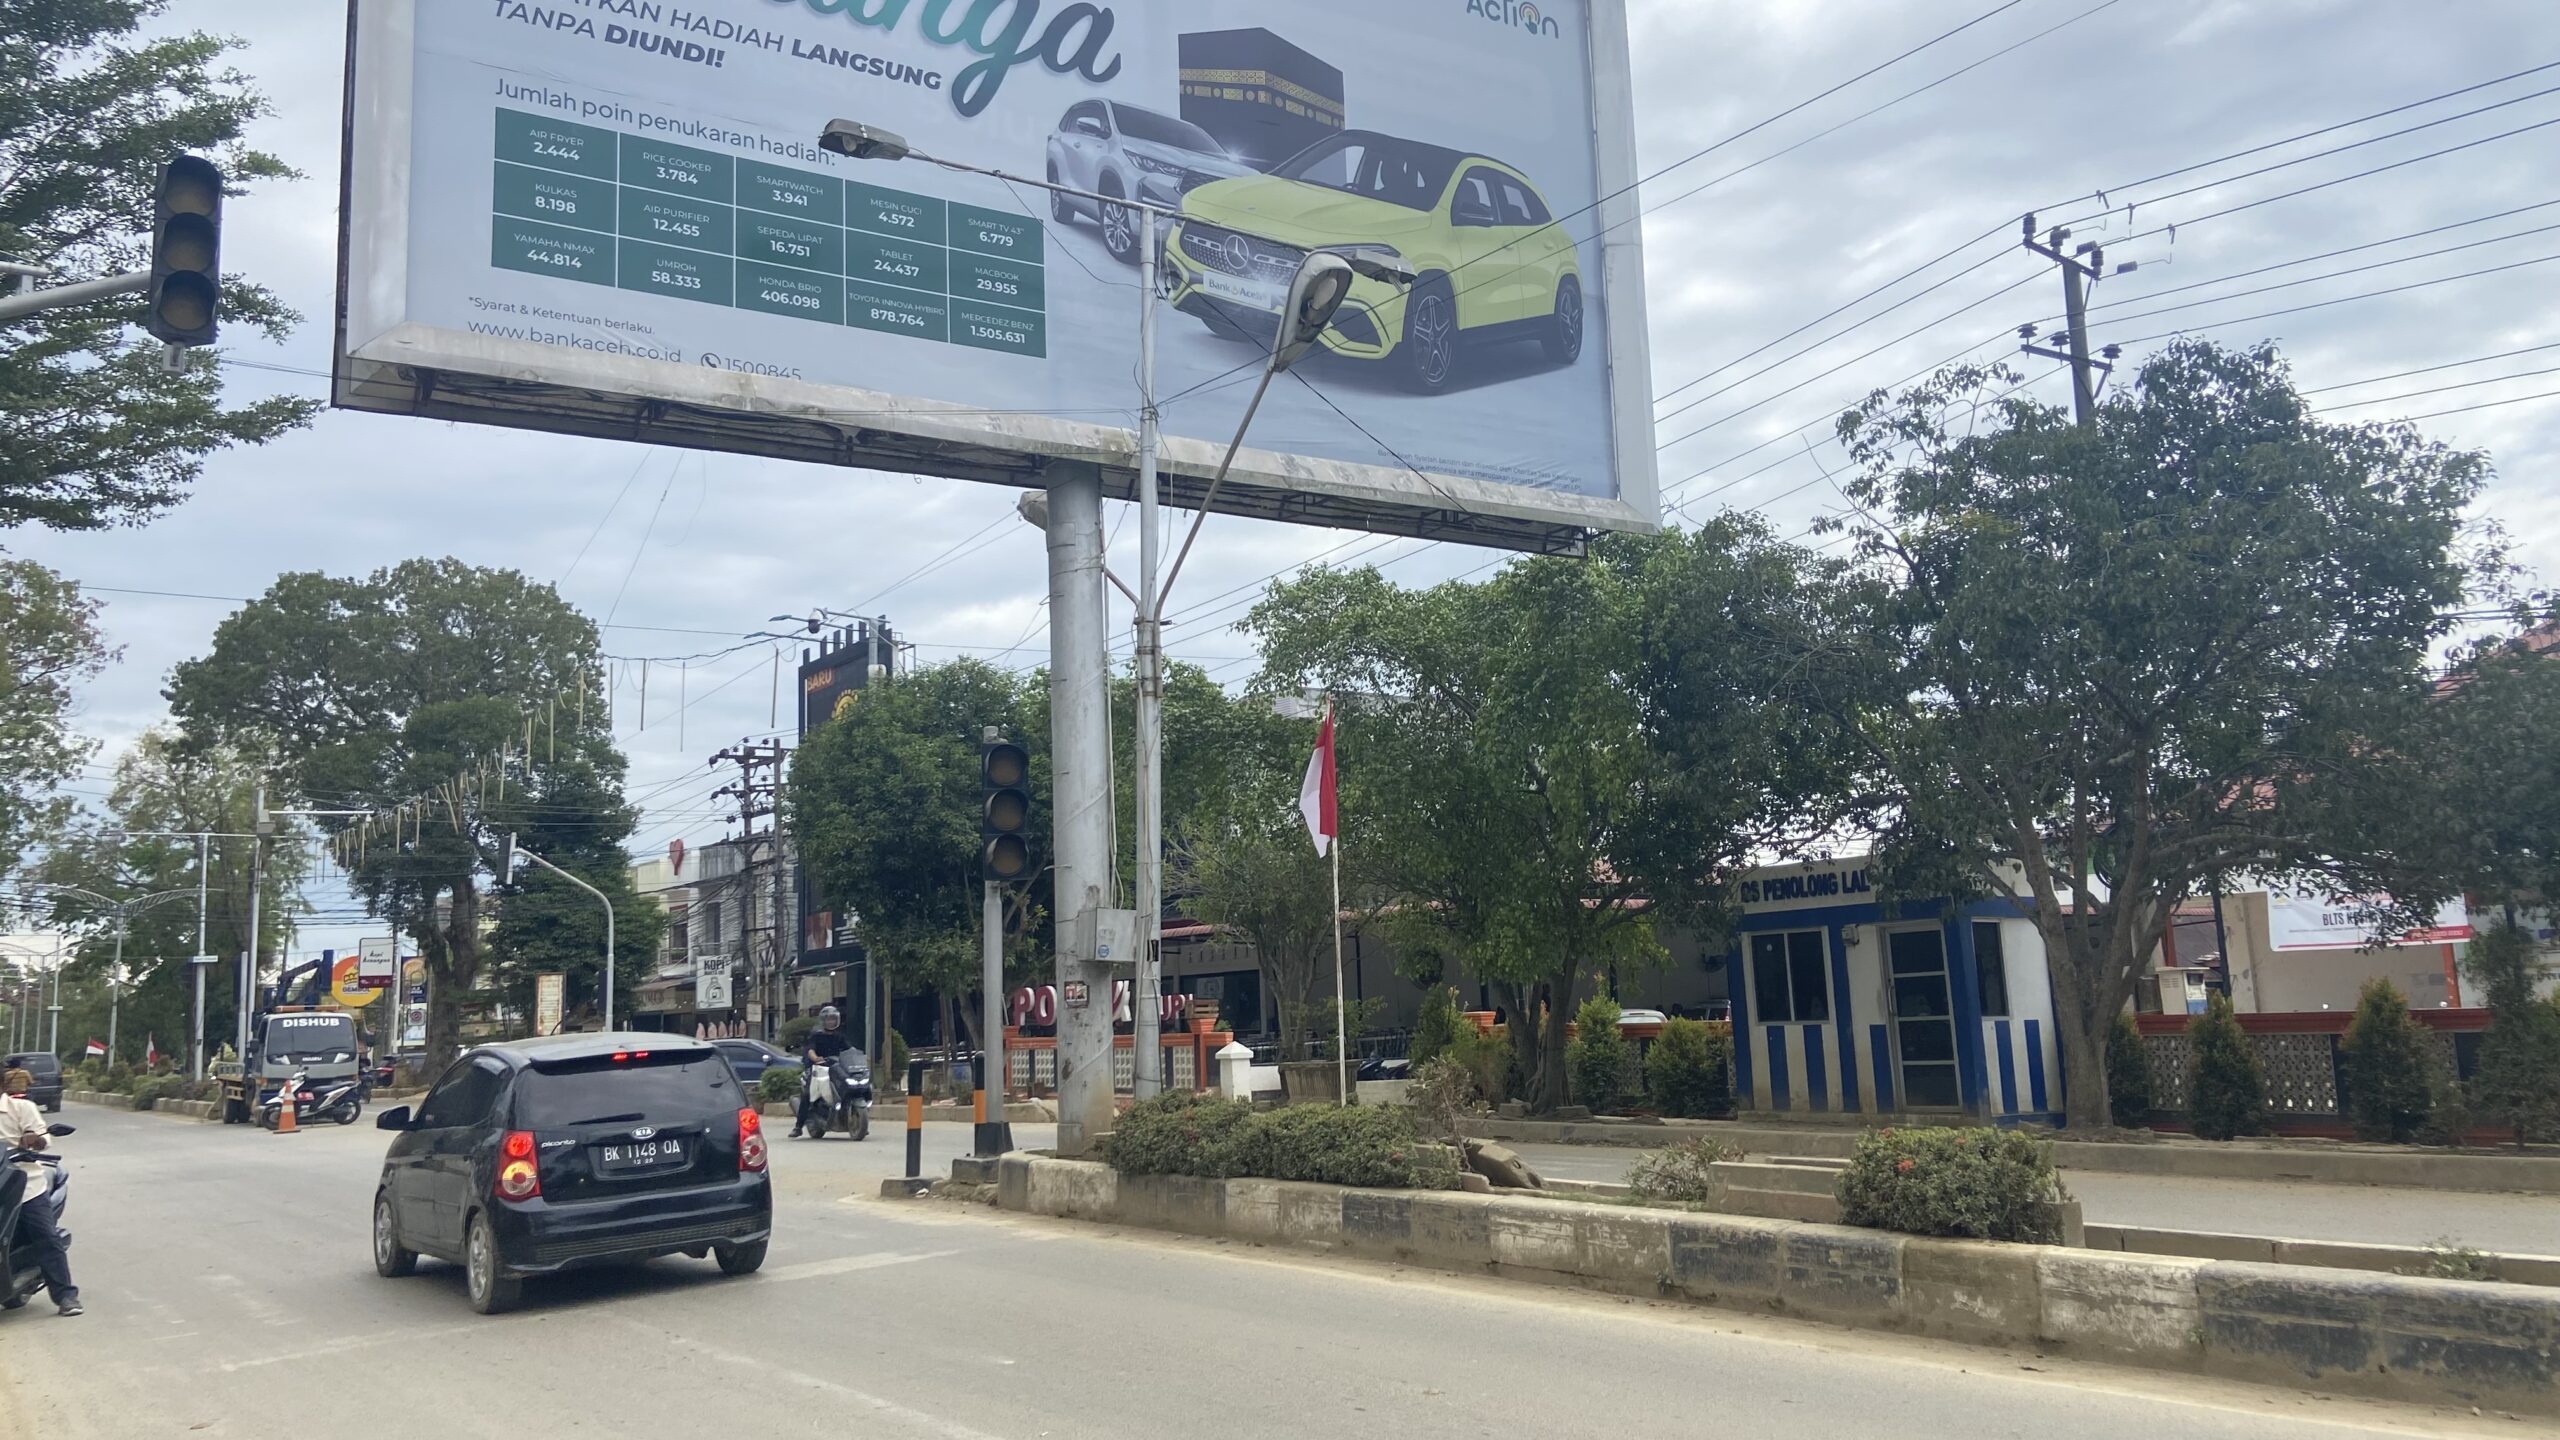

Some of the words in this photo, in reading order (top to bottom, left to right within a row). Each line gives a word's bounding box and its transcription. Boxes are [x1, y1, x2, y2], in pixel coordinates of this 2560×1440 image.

[496, 0, 596, 39] TANPA
[604, 23, 726, 69] DIUNDI!
[670, 9, 785, 52] HADIAH
[791, 38, 943, 91] LANGSUNG
[495, 78, 577, 112] Jumlah
[582, 98, 633, 124] poin
[638, 109, 754, 149] penukaran
[760, 133, 836, 167] hadiah:
[529, 129, 547, 139] AIR
[550, 133, 584, 146] FRYER
[533, 141, 580, 161] 2.444
[643, 152, 666, 164] RICE
[669, 157, 712, 173] COOKER
[656, 166, 698, 185] 3.784
[535, 183, 577, 198] KULKAS
[756, 175, 824, 196] SMARTWATCH
[535, 195, 576, 214] 8.198
[772, 189, 808, 206] 3.941
[870, 198, 899, 211] MESIN
[900, 204, 922, 216] CUCI
[643, 204, 661, 214] AIR
[663, 207, 710, 223] PURIFIER
[878, 211, 915, 227] 4.572
[653, 217, 700, 237] 12.455
[967, 218, 997, 230] SMART
[1000, 223, 1009, 232] TV
[513, 233, 561, 249] YAMAHA
[564, 242, 595, 255] NMAX
[757, 225, 795, 240] SEPEDA
[797, 233, 823, 245] LIPAT
[979, 231, 1014, 247] 6.779
[770, 239, 810, 257] 16.751
[880, 248, 913, 261] TABLET
[527, 249, 582, 269] 44.814
[656, 258, 696, 272] UMROH
[874, 259, 919, 277] 24.437
[652, 270, 701, 289] 58.333
[975, 266, 1020, 281] MACBOOK
[759, 276, 796, 289] HONDA
[798, 282, 822, 294] BRIO
[976, 278, 1018, 295] 29.955
[1208, 279, 1231, 292] Bank
[760, 289, 820, 309] 406.098
[848, 292, 880, 304] TOYOTA
[882, 299, 913, 310] INNOVA
[520, 304, 529, 315] &
[532, 306, 602, 327] Ketentuan
[604, 317, 656, 335] berlaku.
[870, 308, 925, 327] 878.764
[961, 312, 1009, 327] MERCEDEZ
[1011, 320, 1034, 331] BENZ
[468, 320, 681, 363] www.bankaceh.co.id
[970, 325, 1025, 344] 1.505.631
[704, 959, 725, 971] KOPI
[282, 1018, 340, 1028] DISHUB
[604, 1145, 620, 1162] BK
[627, 1142, 657, 1160] 1148
